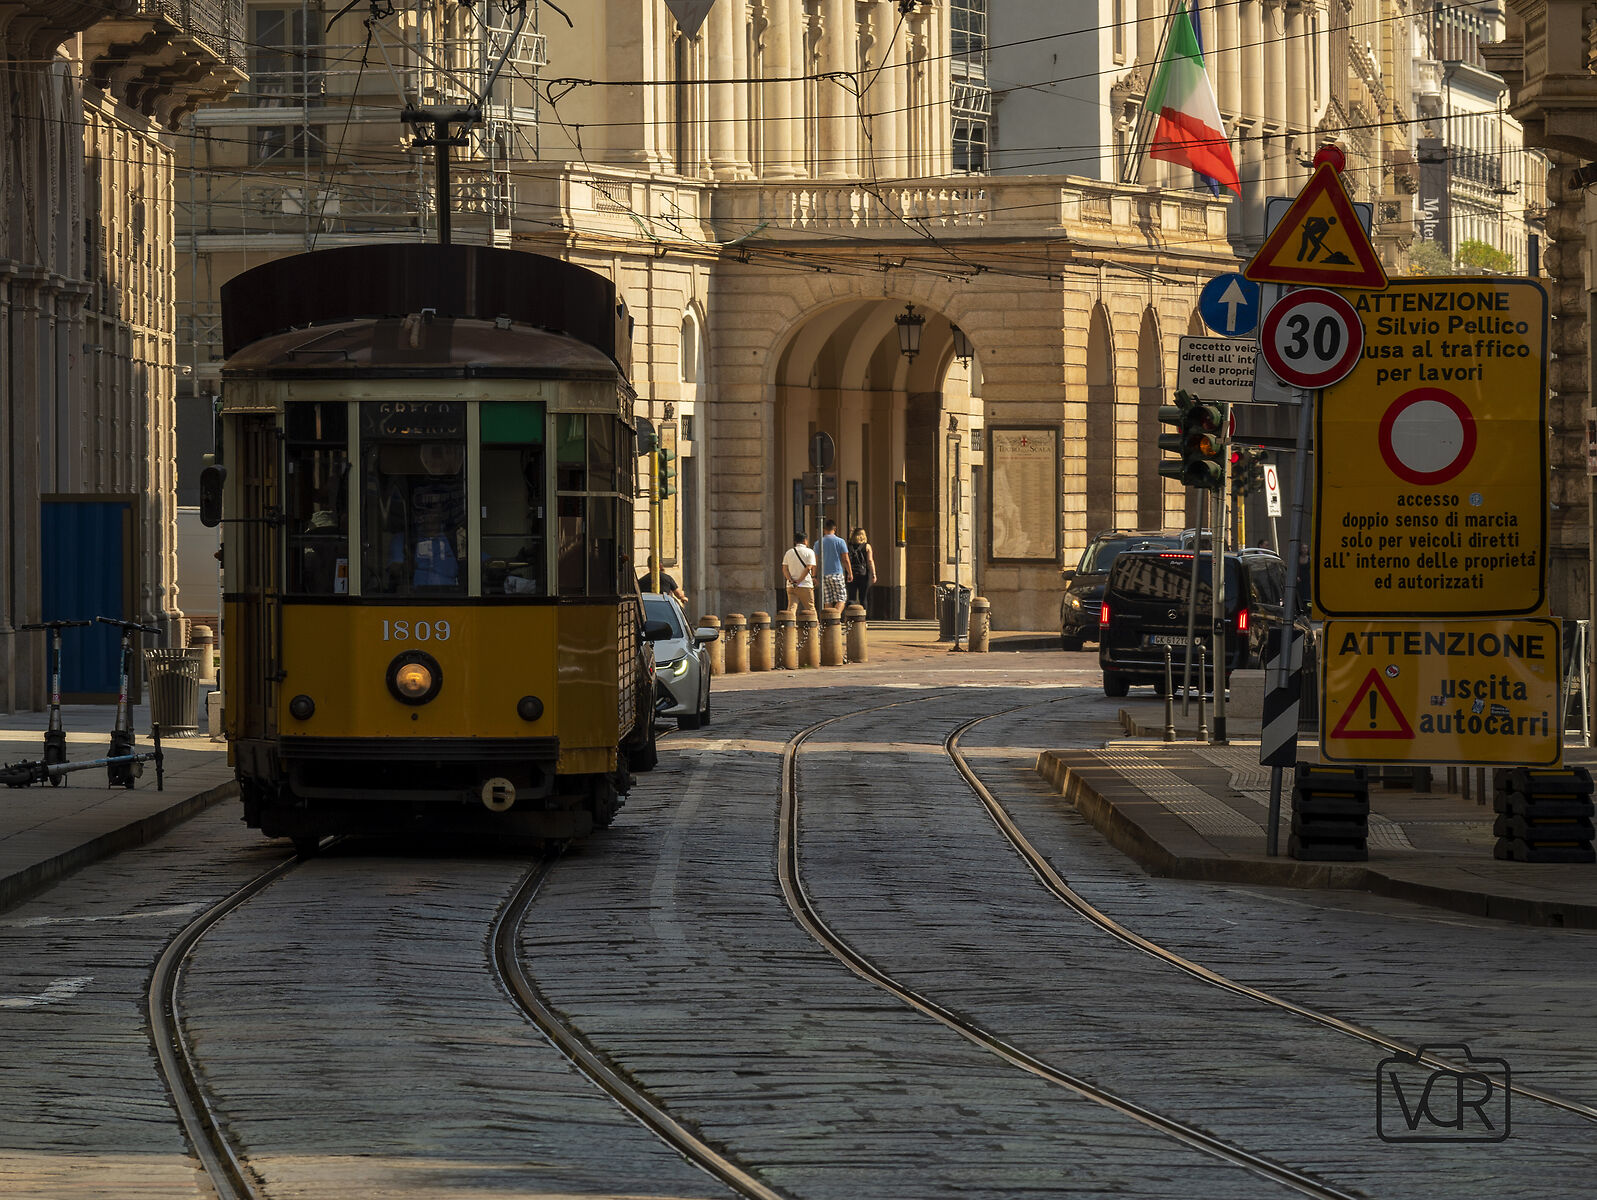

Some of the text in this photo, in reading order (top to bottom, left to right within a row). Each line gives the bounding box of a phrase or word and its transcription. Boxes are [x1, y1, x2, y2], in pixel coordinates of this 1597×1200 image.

[1355, 292, 1510, 312] ATTENZIONE
[1376, 316, 1440, 336] Silvio
[1448, 315, 1528, 335] Pellico
[1284, 314, 1340, 361] 30
[1189, 342, 1231, 352] eccetto
[1412, 340, 1432, 358] al
[1440, 339, 1530, 358] traffico
[1182, 352, 1215, 362] diretti
[1218, 354, 1235, 364] all'
[1190, 364, 1215, 373] delle
[1376, 363, 1483, 386] per lavori
[1192, 376, 1206, 385] ed
[1397, 494, 1459, 507] accesso
[1342, 512, 1518, 530] doppio senso di marcia
[1341, 532, 1519, 550] solo per veicoli diretti
[1324, 552, 1350, 568] all'
[1356, 553, 1410, 568] interno
[1417, 552, 1458, 568] delle
[1374, 574, 1484, 589] ed autorizzati
[382, 620, 451, 641] 1809
[1339, 632, 1545, 659] ATTENZIONE
[1441, 674, 1528, 700] uscita
[1419, 709, 1549, 737] autocarri
